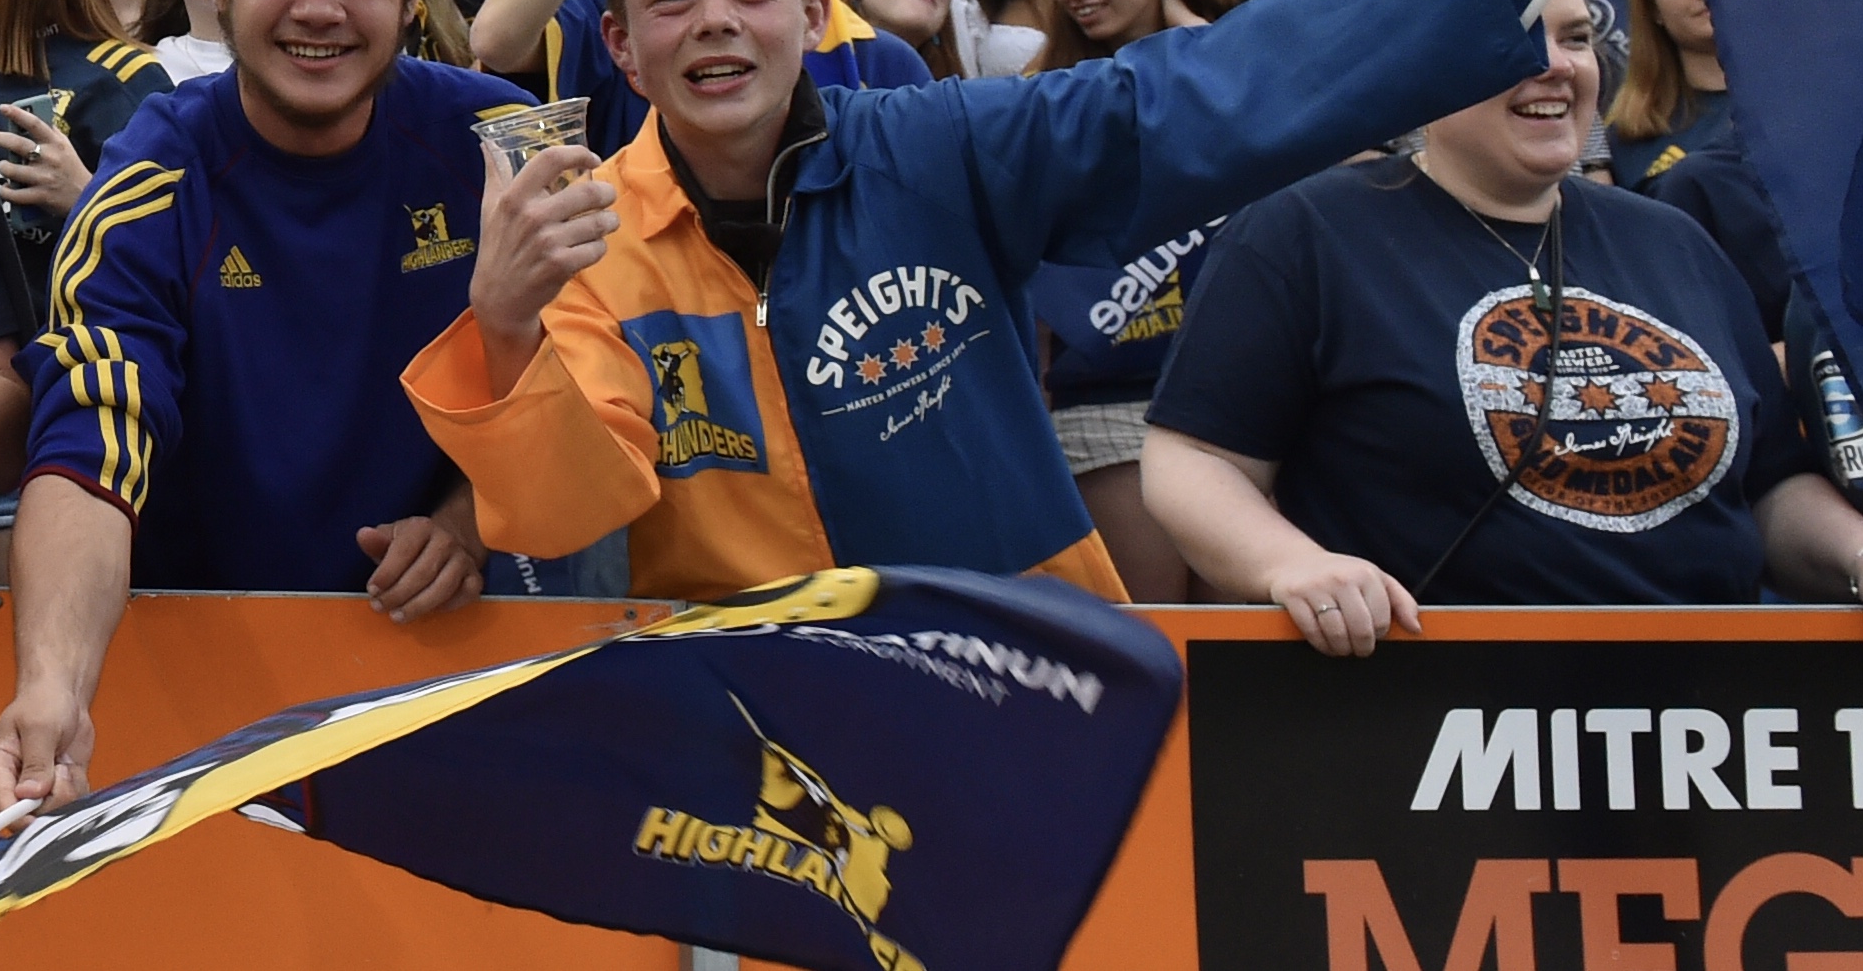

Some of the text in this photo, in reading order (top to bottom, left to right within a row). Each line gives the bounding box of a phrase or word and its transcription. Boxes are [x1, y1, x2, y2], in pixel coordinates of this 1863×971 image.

[807, 266, 983, 388] SPEIGHT'S
[1548, 347, 1605, 358] ASTER
[1547, 355, 1614, 367] REWERS
[1410, 708, 1803, 811] MITRE
